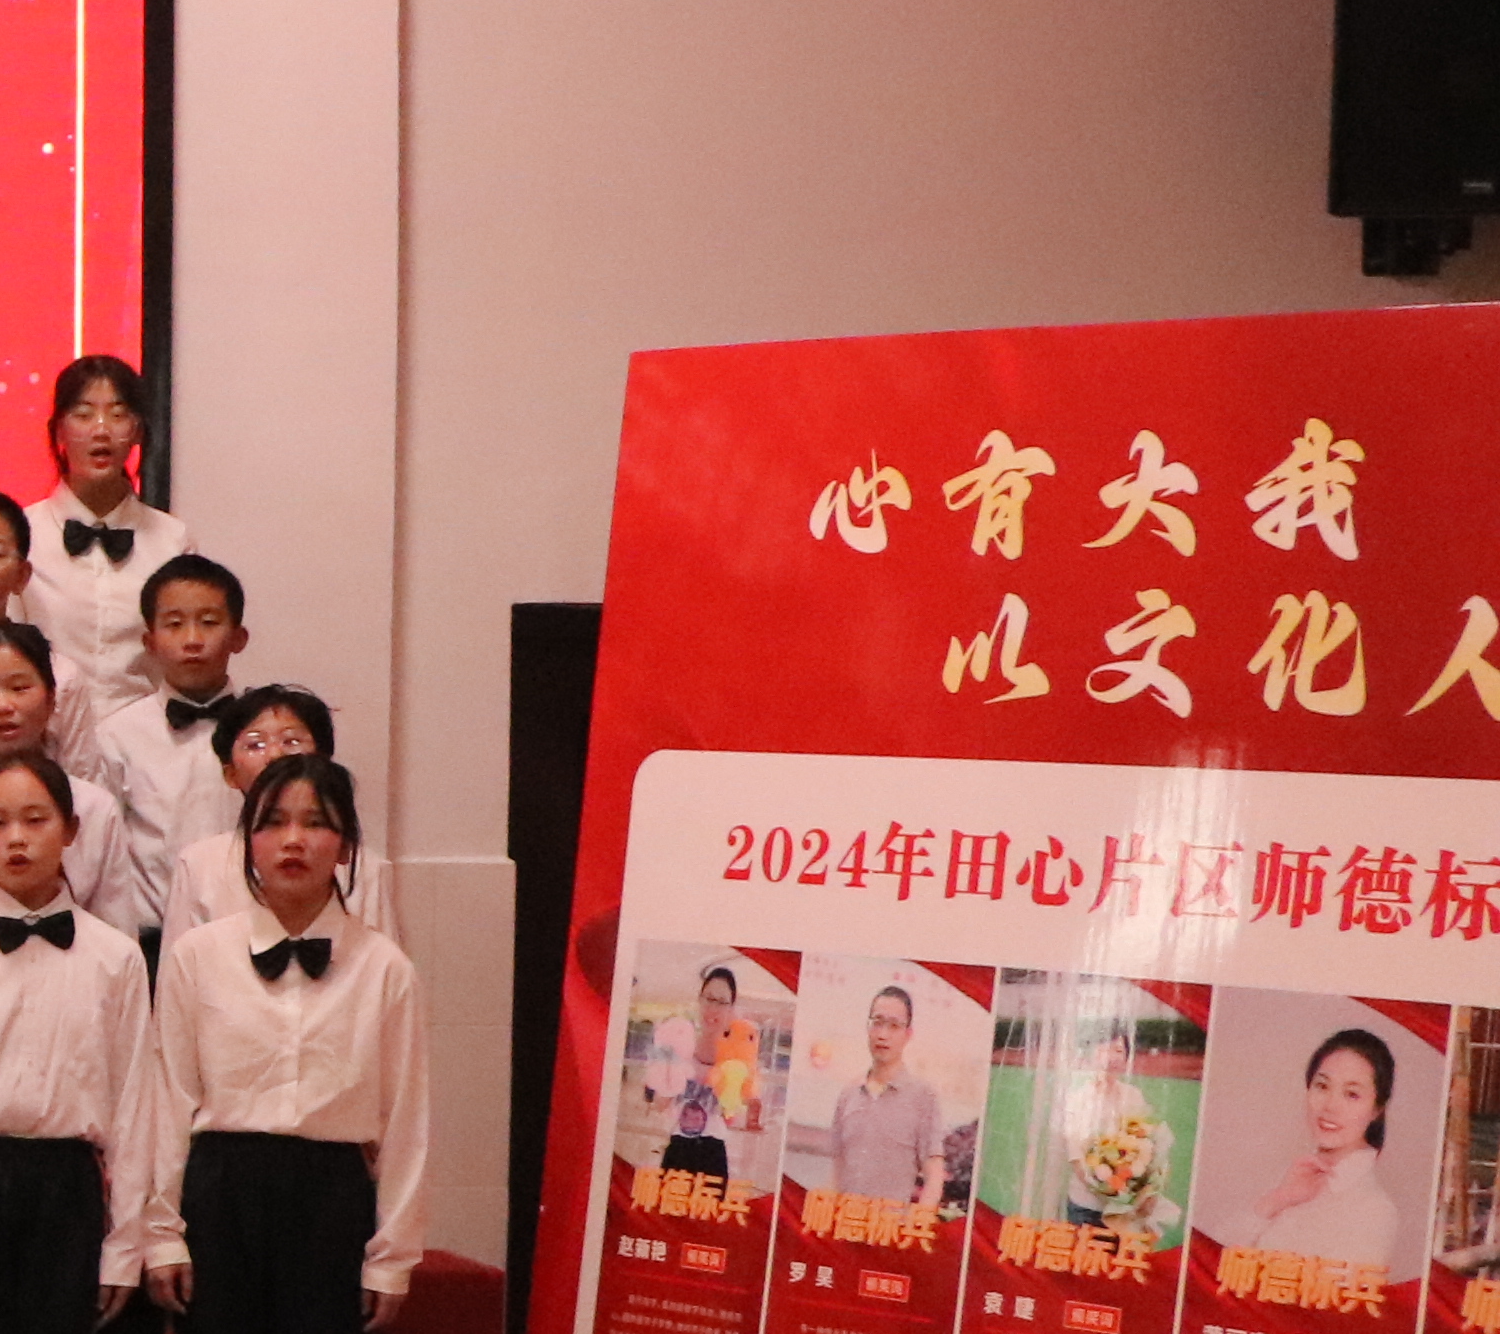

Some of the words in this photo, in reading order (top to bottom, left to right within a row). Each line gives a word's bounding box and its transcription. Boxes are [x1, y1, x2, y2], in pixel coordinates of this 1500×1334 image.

[809, 418, 1366, 561] 心有大我
[723, 819, 1500, 942] 2024年田心片区师德标
[630, 1166, 751, 1227] 师德标兵
[801, 1188, 941, 1253] 师德标兵
[997, 1213, 1158, 1285] 师德标兵
[1216, 1244, 1388, 1319] 师德标兵
